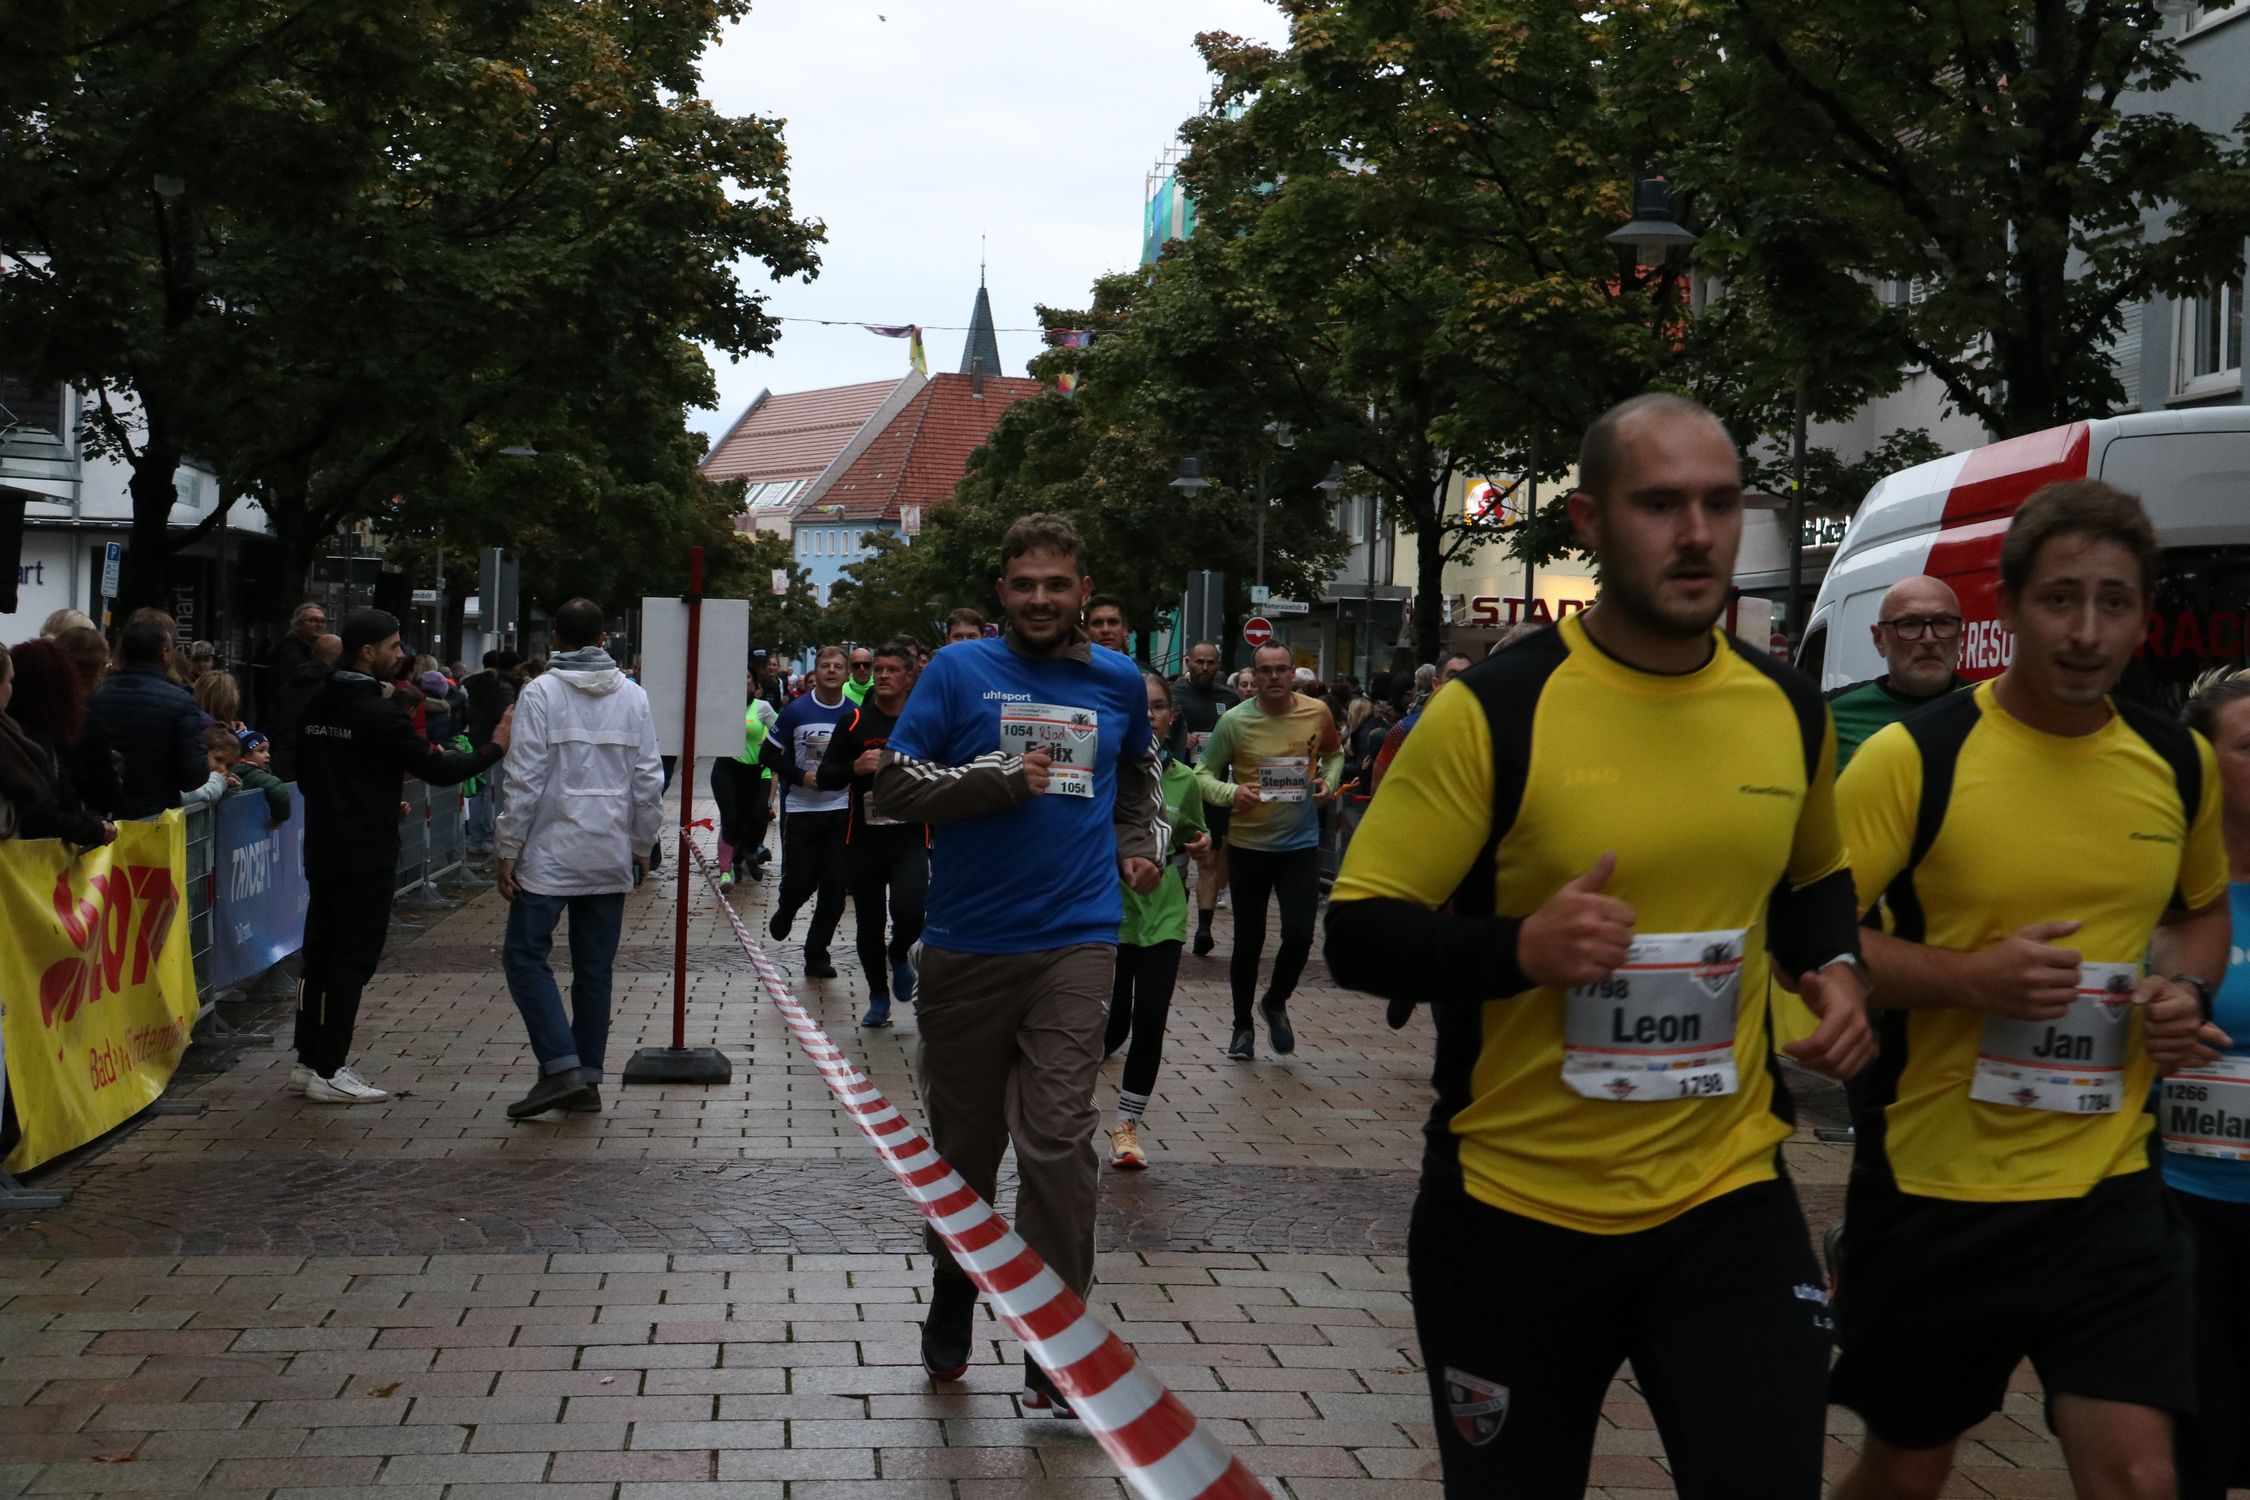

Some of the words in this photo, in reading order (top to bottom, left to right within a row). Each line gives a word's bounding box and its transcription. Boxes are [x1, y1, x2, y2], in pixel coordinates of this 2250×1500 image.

[983, 690, 1032, 702] uhlsport
[1004, 724, 1034, 737] 1054
[1061, 781, 1086, 794] 1054
[1262, 777, 1305, 789] Stephan
[1612, 1008, 1701, 1043] Leon
[2034, 1027, 2093, 1061] Jan
[2166, 1085, 2208, 1102] 1266
